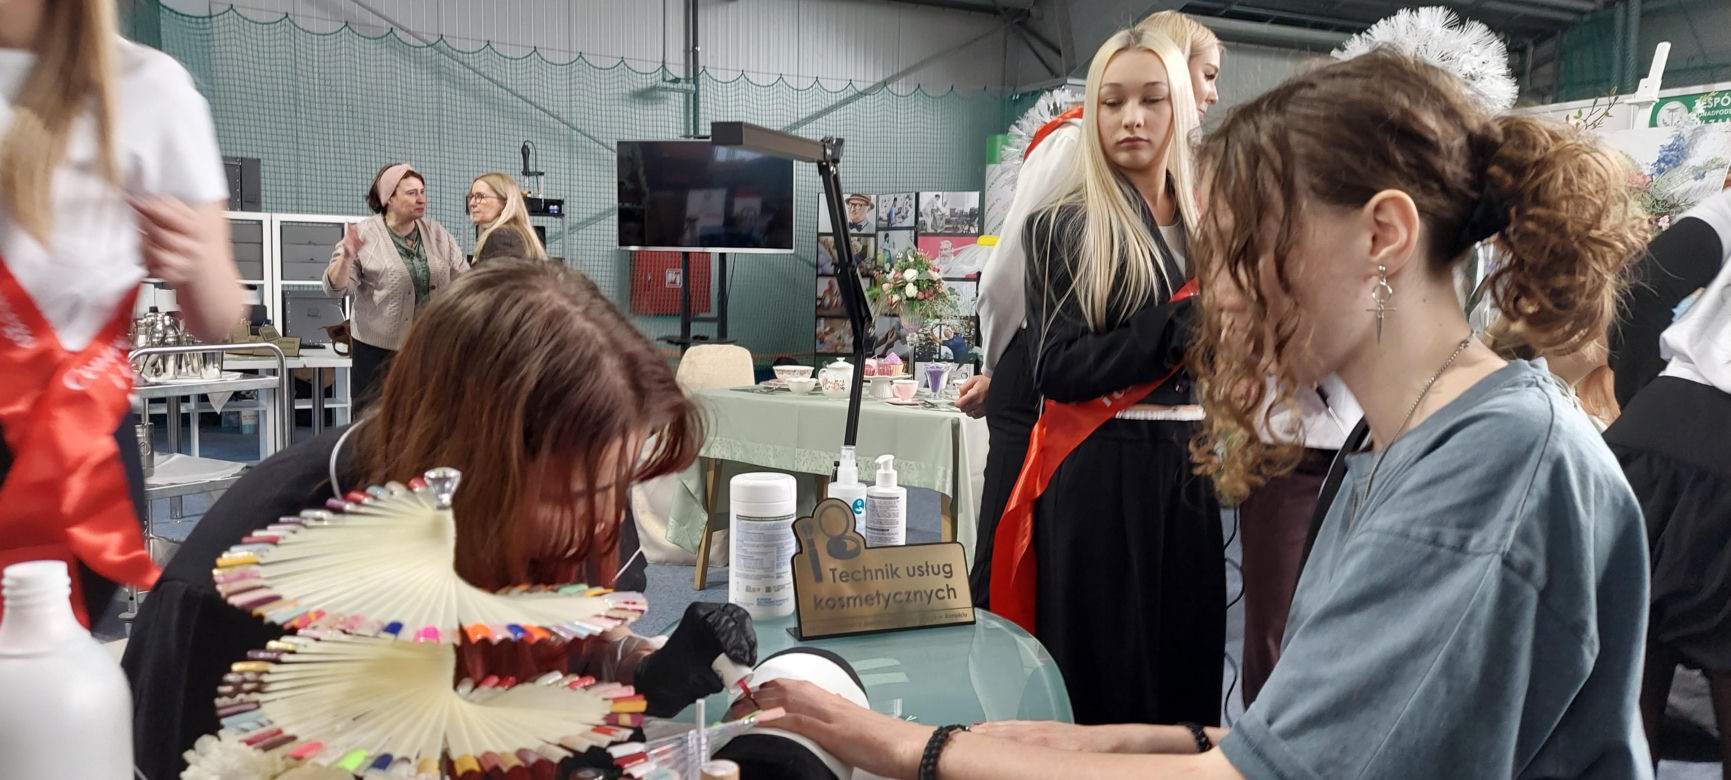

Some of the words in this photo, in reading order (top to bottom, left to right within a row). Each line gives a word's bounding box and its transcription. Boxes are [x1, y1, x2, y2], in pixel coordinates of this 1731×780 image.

[829, 563, 901, 584] Technik
[906, 560, 953, 579] usług
[813, 584, 957, 611] kosmetycznych
